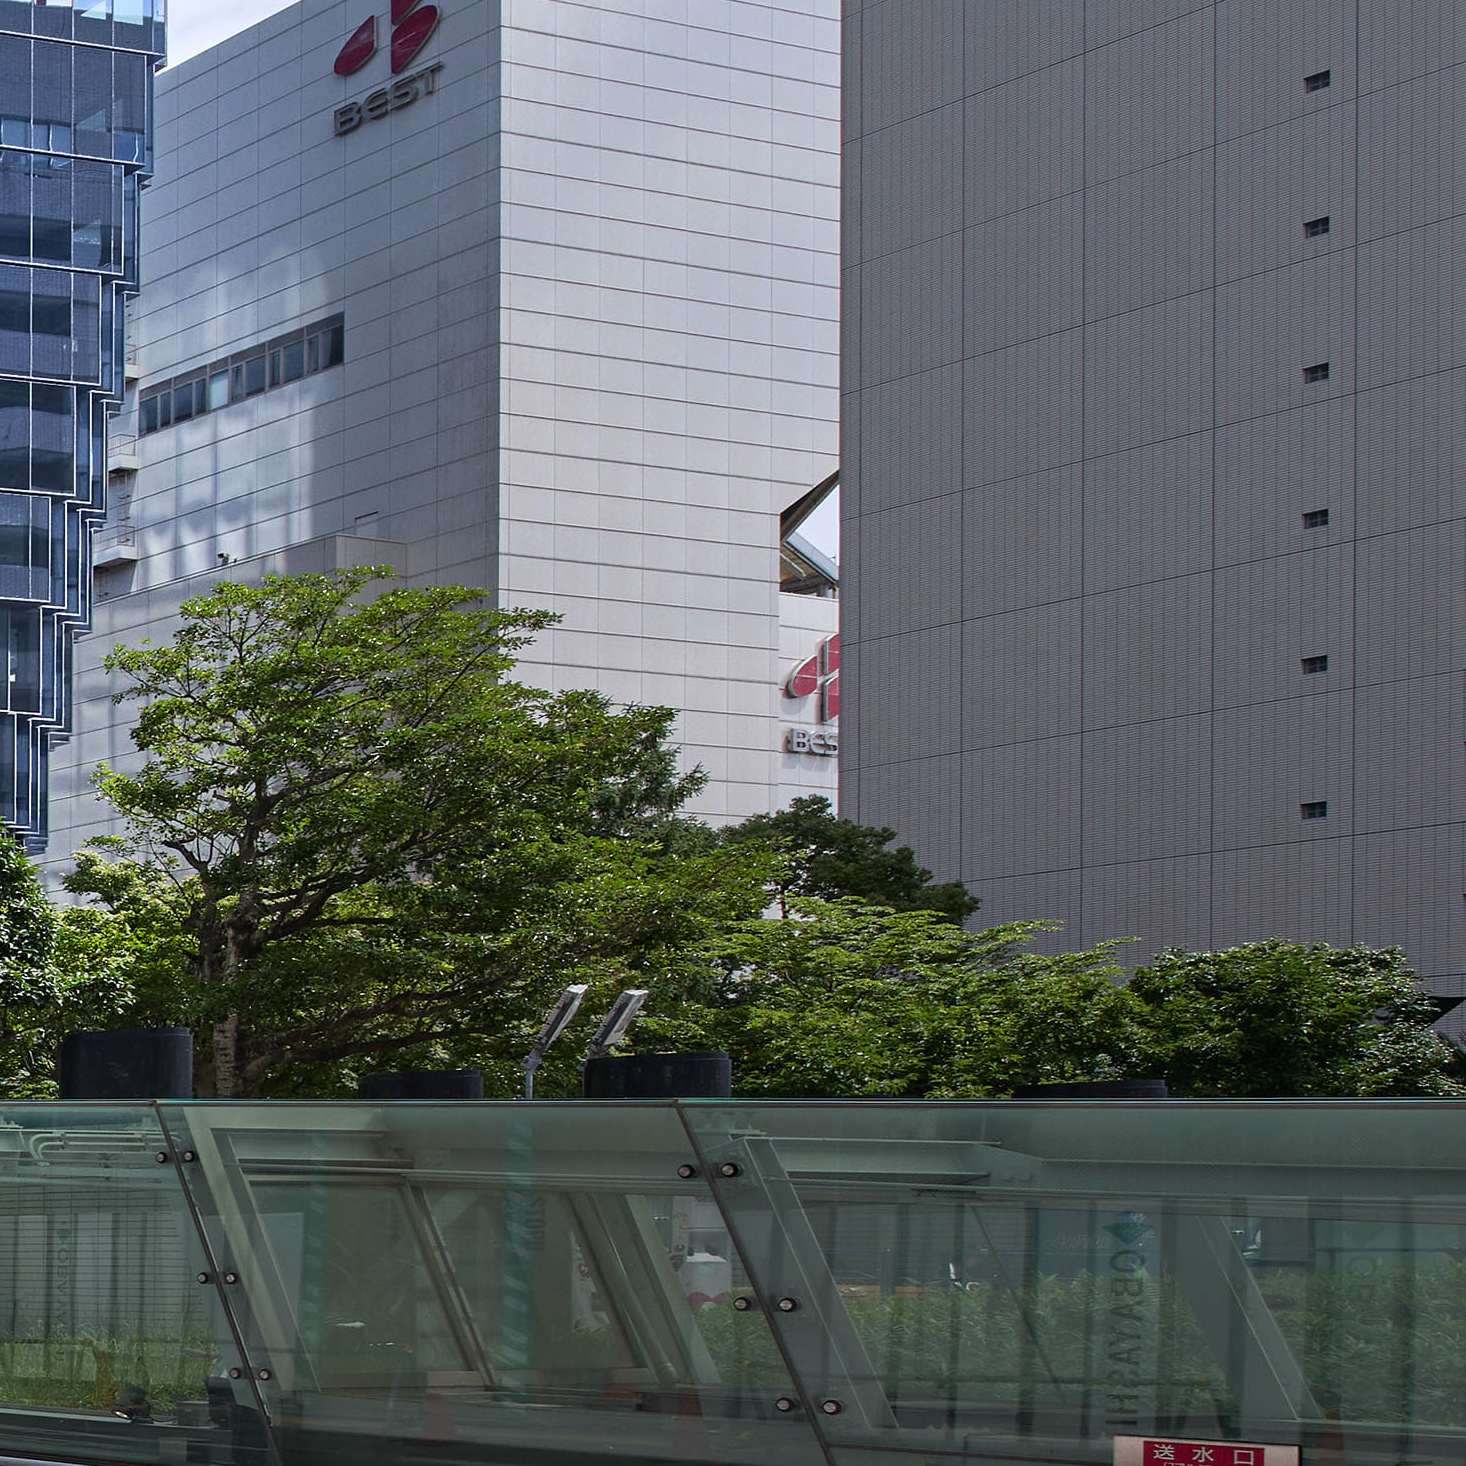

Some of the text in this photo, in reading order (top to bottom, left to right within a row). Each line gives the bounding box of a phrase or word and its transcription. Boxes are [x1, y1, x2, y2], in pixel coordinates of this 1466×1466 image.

[334, 61, 444, 137] BEST
[787, 728, 839, 756] BES
[1153, 1444, 1255, 1465] 送水口
